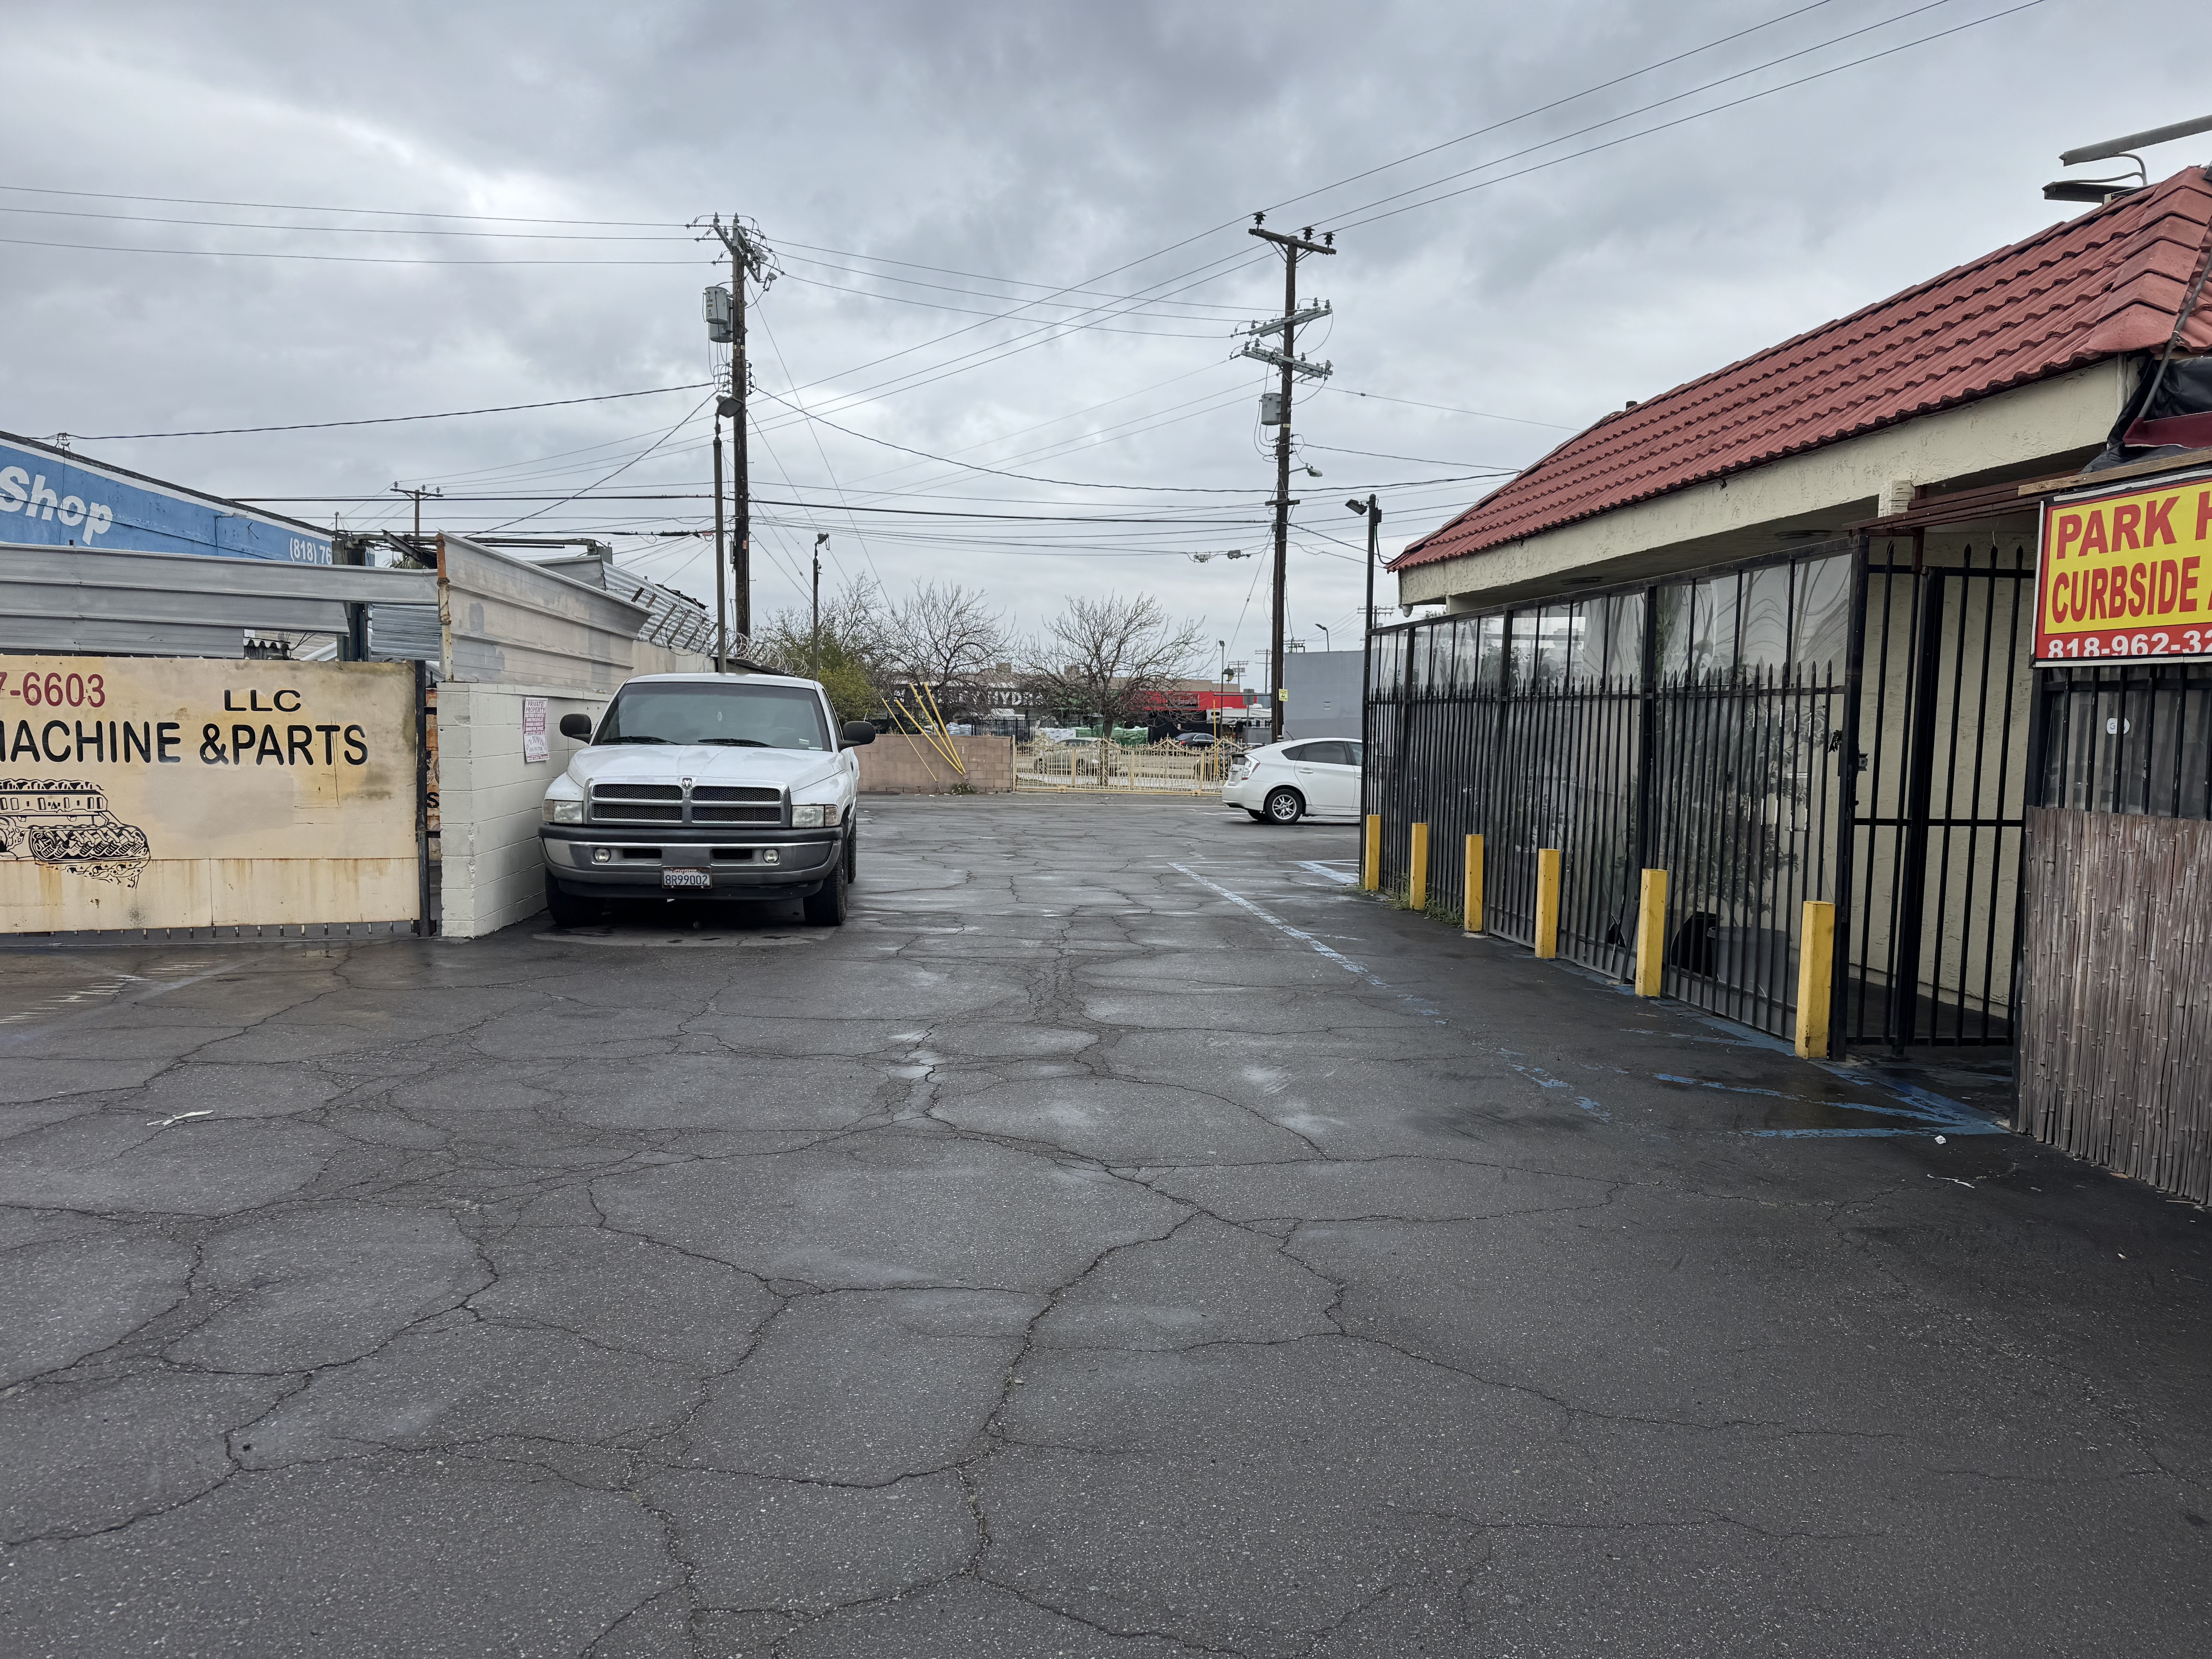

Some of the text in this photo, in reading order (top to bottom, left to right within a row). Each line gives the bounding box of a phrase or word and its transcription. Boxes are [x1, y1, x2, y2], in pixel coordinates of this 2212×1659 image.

[0, 466, 113, 546] Shop
[2057, 496, 2181, 560] PARK
[290, 538, 317, 565] (818)
[2052, 556, 2201, 623] CURBSIDE
[224, 689, 301, 712] LLC
[199, 723, 368, 765] &PARTS
[665, 875, 708, 885] 8R99002
